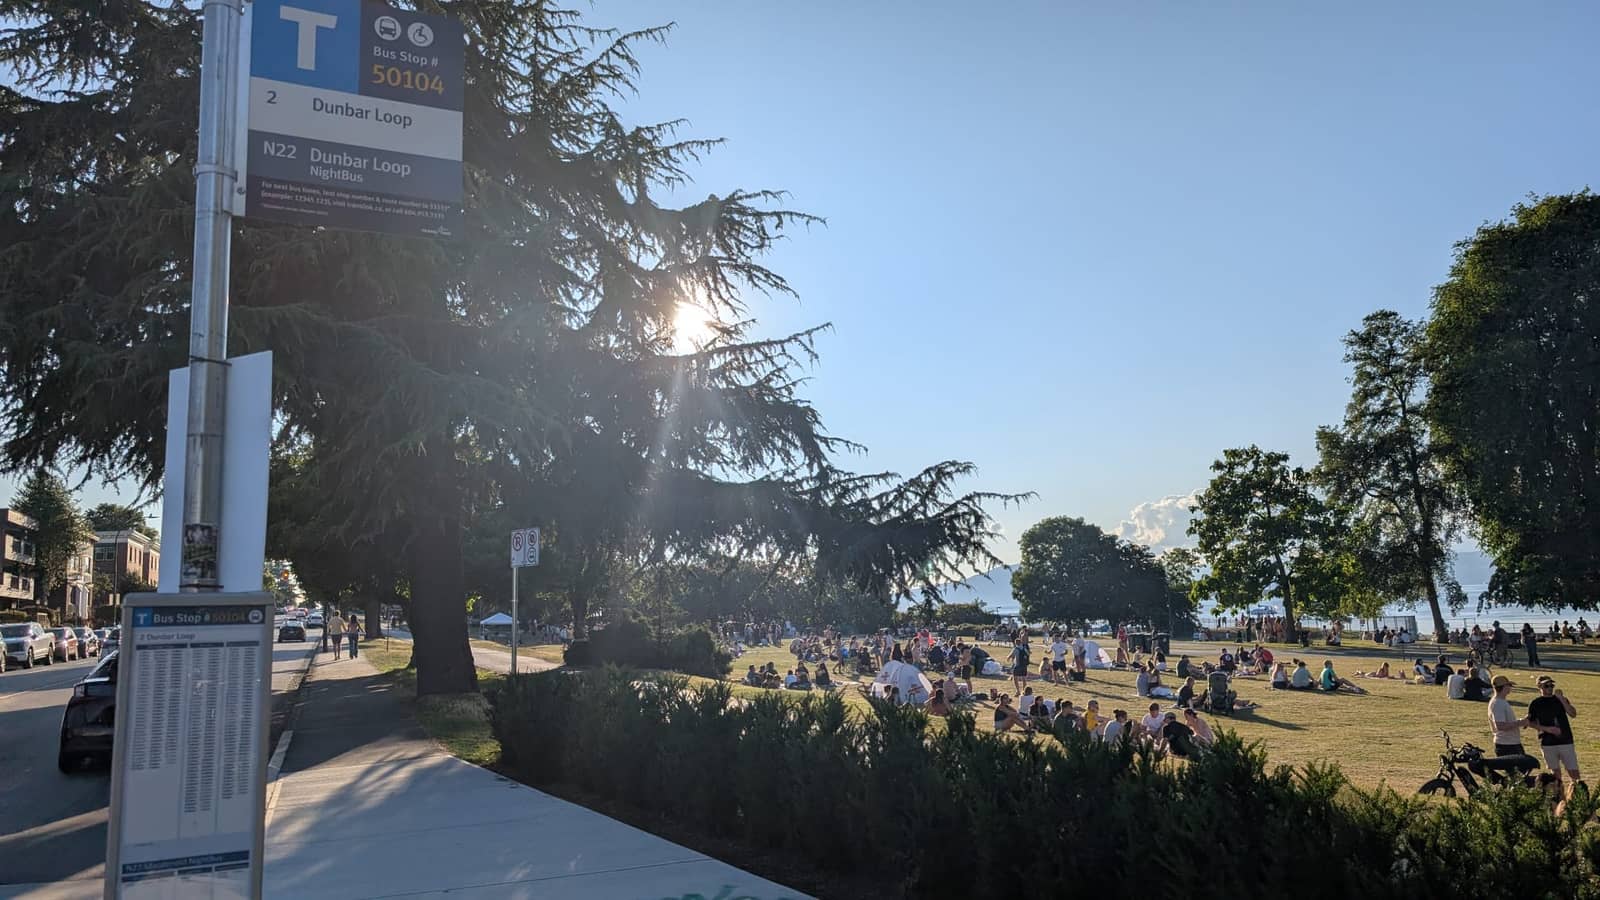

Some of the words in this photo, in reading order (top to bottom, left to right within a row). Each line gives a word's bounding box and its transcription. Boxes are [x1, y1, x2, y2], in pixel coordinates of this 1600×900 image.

[279, 5, 338, 71] T
[373, 46, 397, 60] Bus
[400, 51, 428, 67] Stop
[431, 55, 439, 67] #
[372, 63, 445, 95] 50104
[266, 90, 277, 104] 2
[312, 97, 371, 121] Dunbar
[375, 109, 413, 129] Loop
[263, 140, 297, 159] N22
[310, 147, 369, 170] Dunbar
[373, 157, 411, 178] Loop
[310, 165, 364, 183] NightBus
[135, 614, 148, 625] T
[153, 614, 174, 624] Bus
[176, 613, 201, 625] Stop
